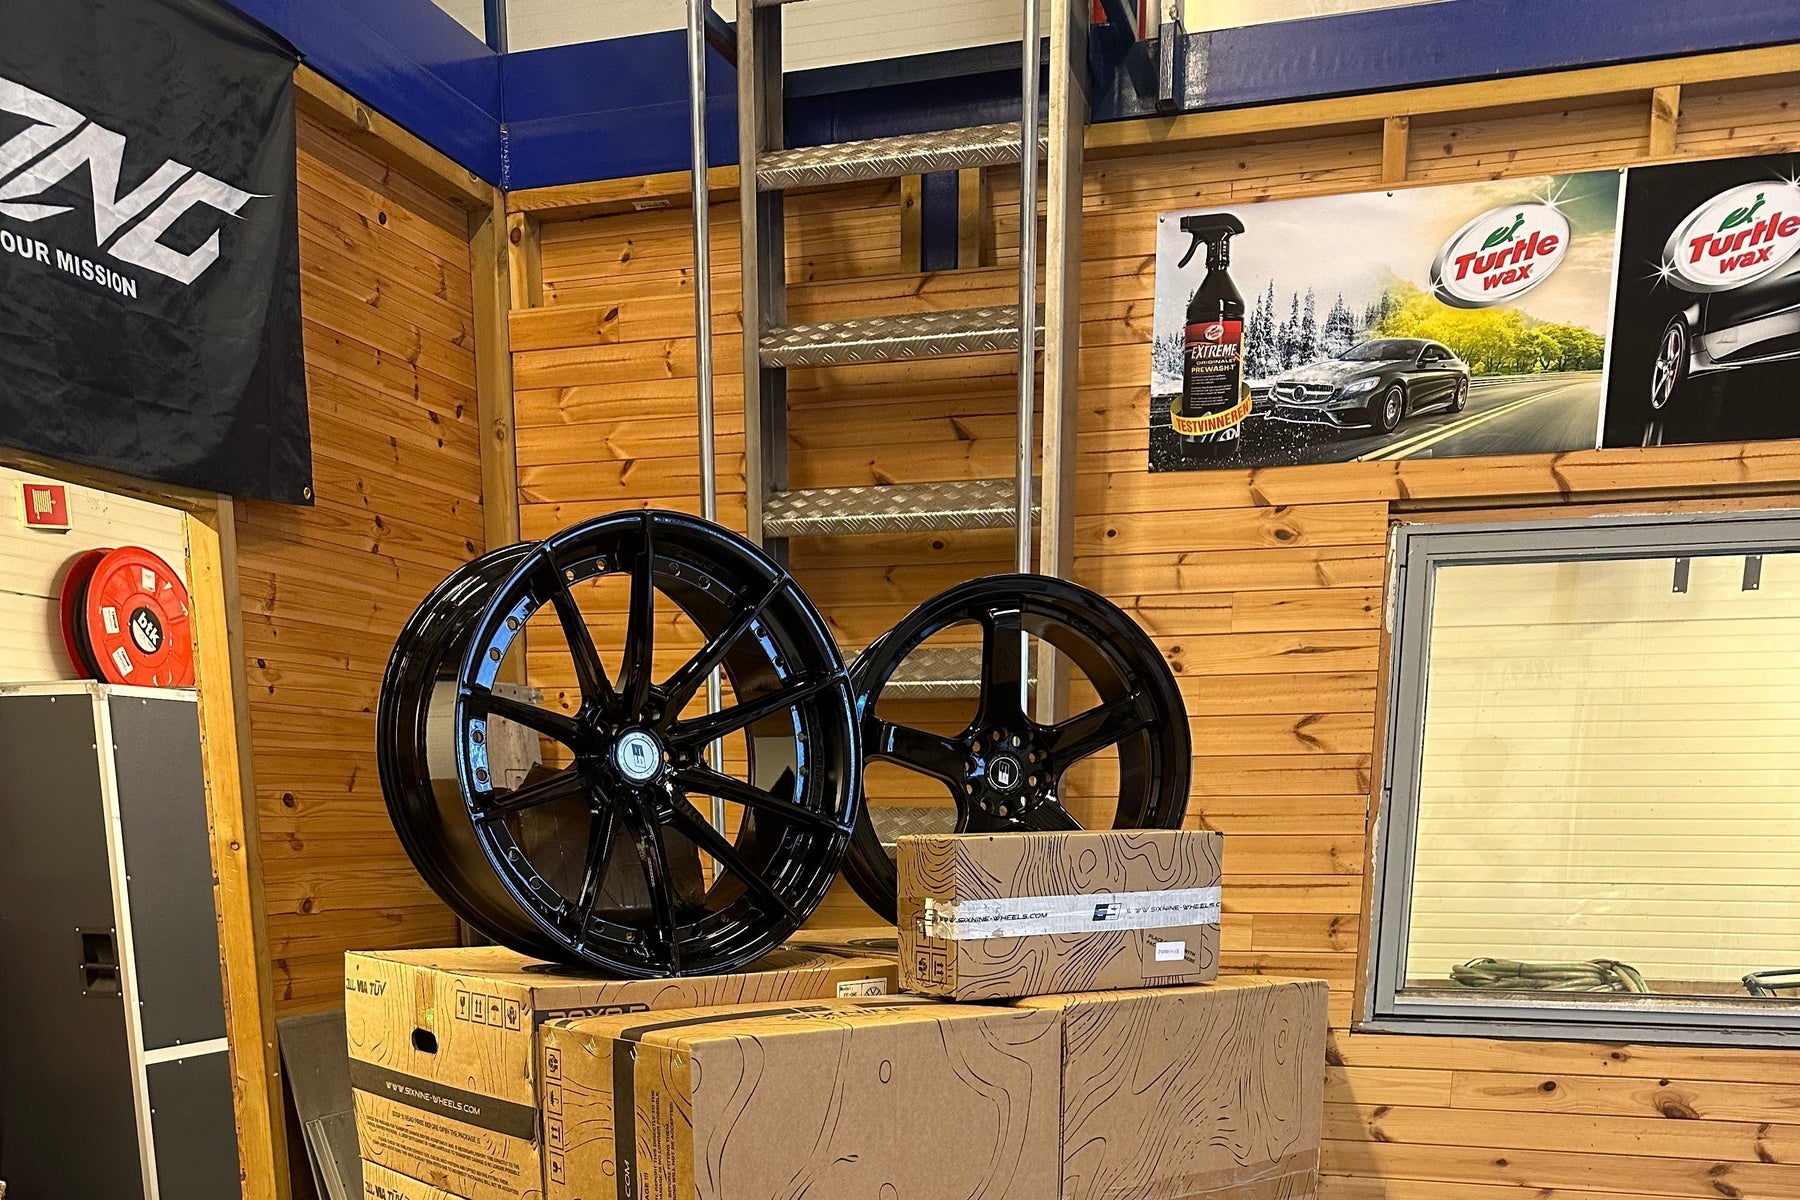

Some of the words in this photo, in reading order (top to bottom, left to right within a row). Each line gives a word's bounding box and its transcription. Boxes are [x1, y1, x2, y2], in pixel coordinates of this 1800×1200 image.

[1689, 211, 1800, 264] Turtle
[0, 230, 51, 266] OUR
[56, 248, 138, 299] MISSION
[1454, 230, 1559, 282] Turtle
[1720, 244, 1775, 274] wax
[1483, 262, 1535, 291] wax
[1191, 343, 1237, 360] EXTREME
[1176, 401, 1249, 433] TESTVINNEREN
[138, 611, 160, 645] btk
